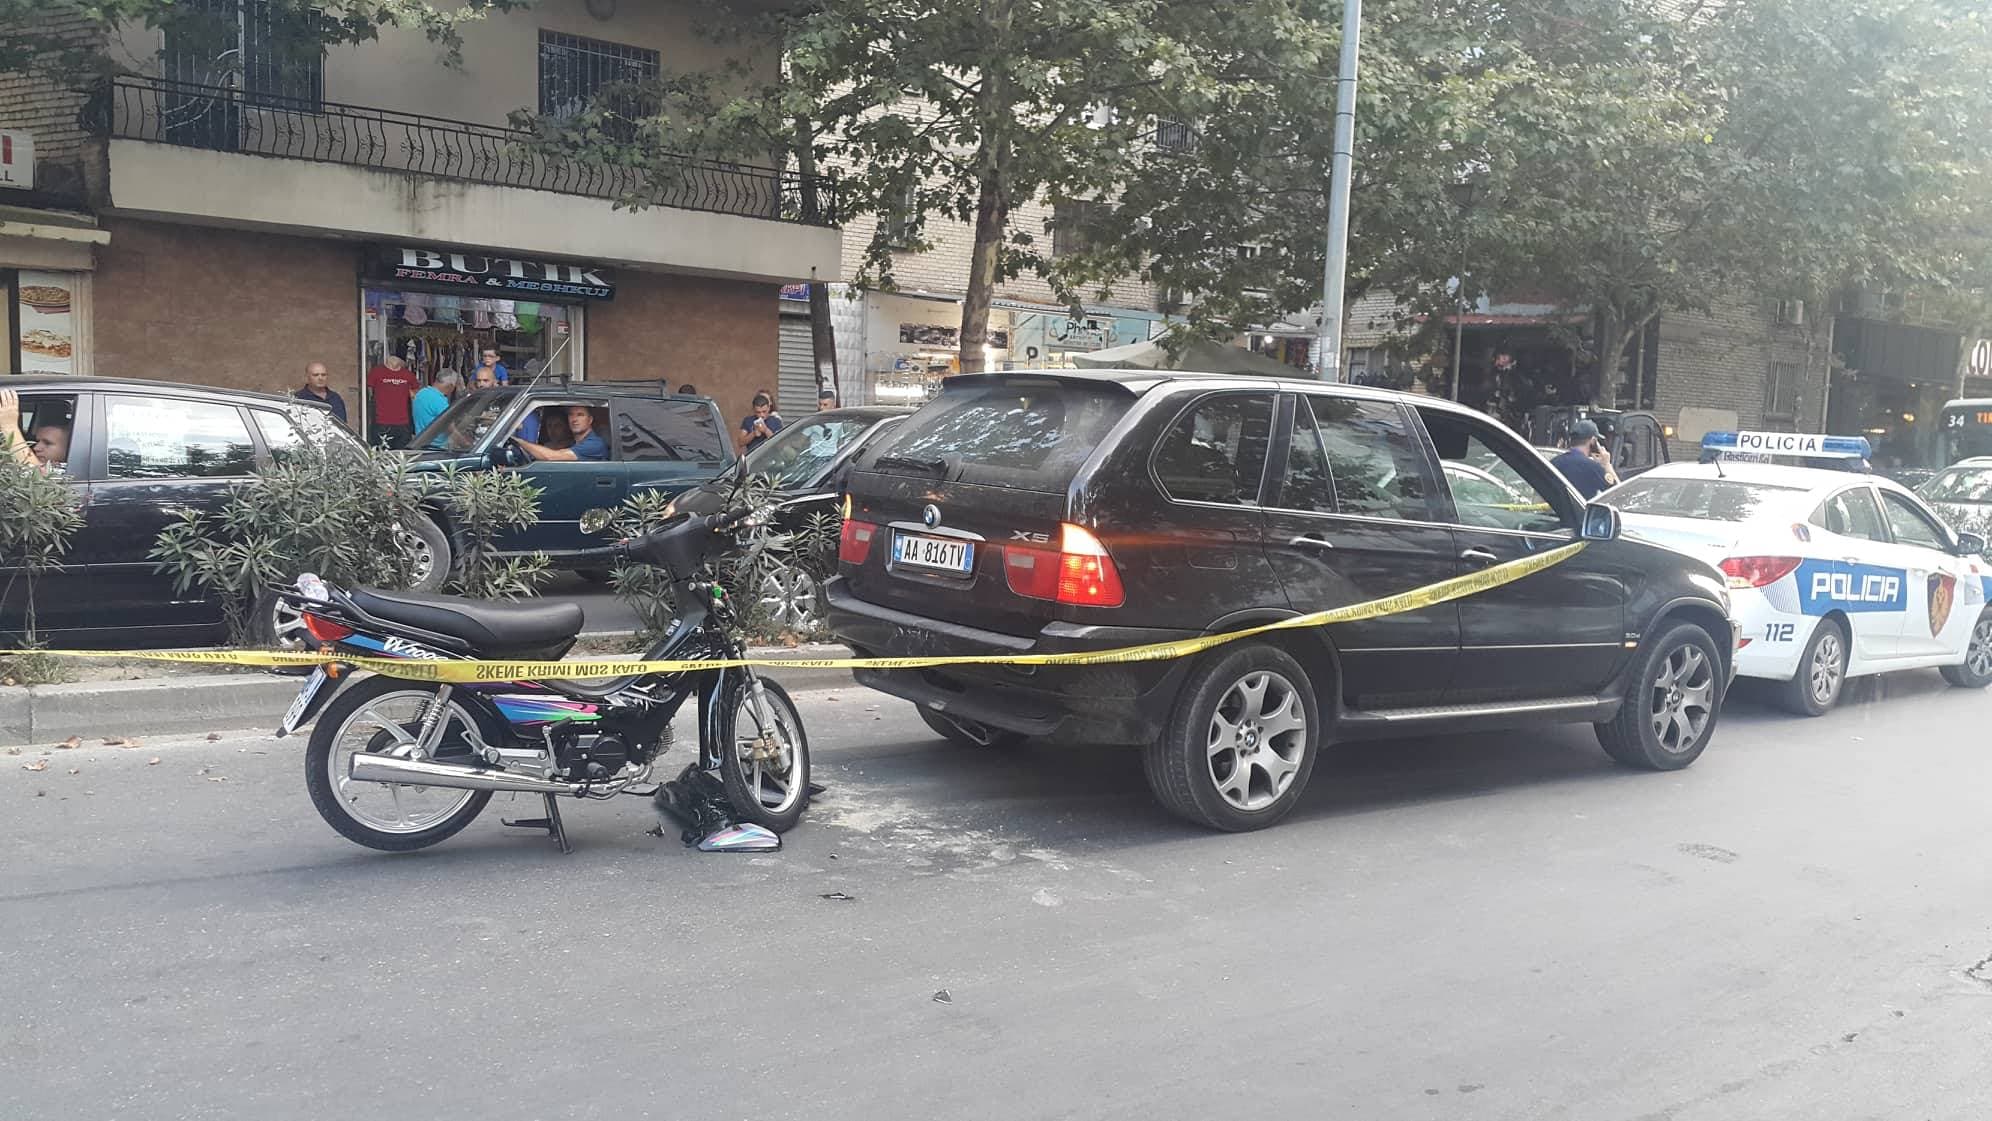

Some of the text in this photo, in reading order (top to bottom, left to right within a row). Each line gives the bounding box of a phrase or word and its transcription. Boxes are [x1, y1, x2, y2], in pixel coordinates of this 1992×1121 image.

[397, 248, 611, 287] BUTIK
[395, 268, 610, 297] FEMRA & MESHKUJ
[1947, 415, 1965, 427] 34
[1740, 434, 1817, 452] POLICIA
[1009, 529, 1050, 544] X5
[904, 539, 965, 567] AA 816 TV
[1810, 573, 1900, 602] POLICIA
[1764, 623, 1795, 642] 112
